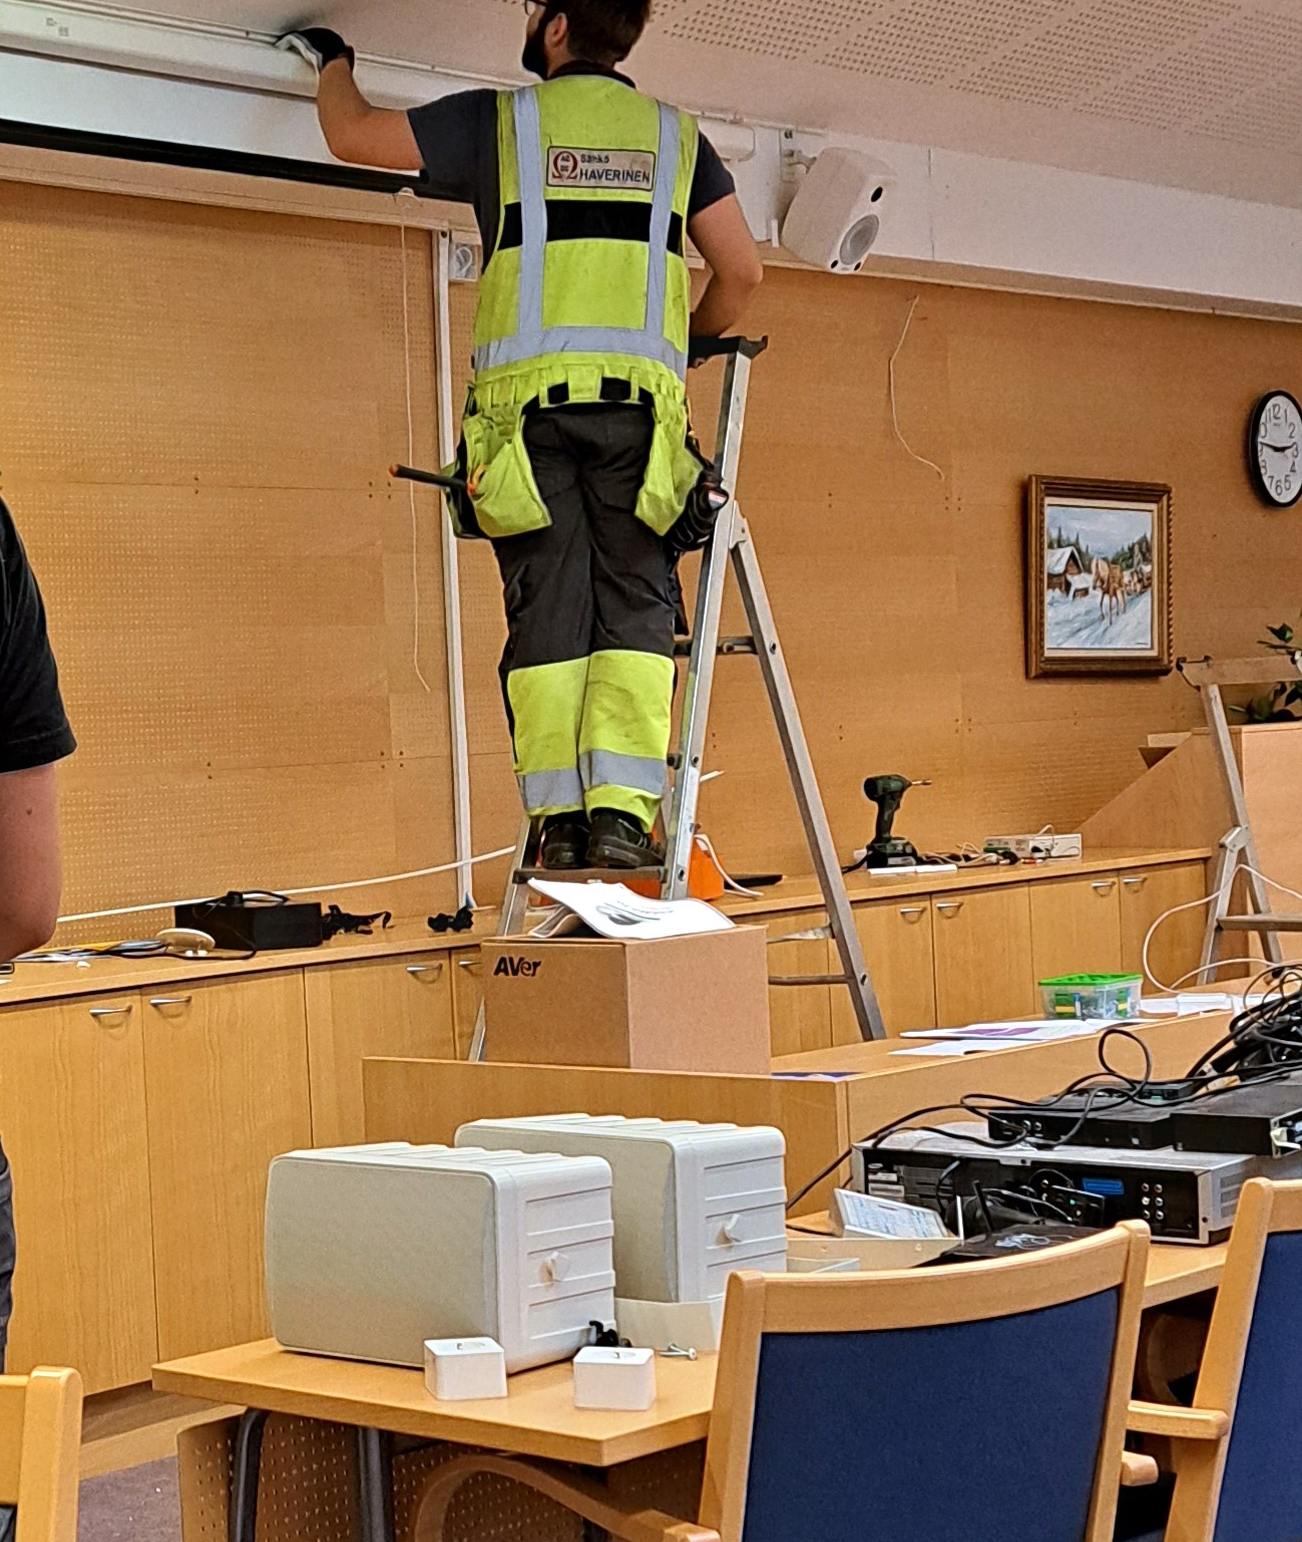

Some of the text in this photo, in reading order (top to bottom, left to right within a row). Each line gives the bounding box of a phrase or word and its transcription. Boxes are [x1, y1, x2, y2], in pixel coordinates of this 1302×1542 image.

[579, 168, 650, 184] HAVERINEN
[1265, 408, 1271, 424] 11
[1272, 403, 1281, 420] 12
[1284, 408, 1288, 424] 1
[1288, 422, 1296, 439] 2
[1289, 460, 1297, 473] 4
[1268, 475, 1275, 490] 7
[1275, 479, 1283, 496] 6
[1284, 474, 1291, 491] 5
[493, 956, 542, 977] AVer
